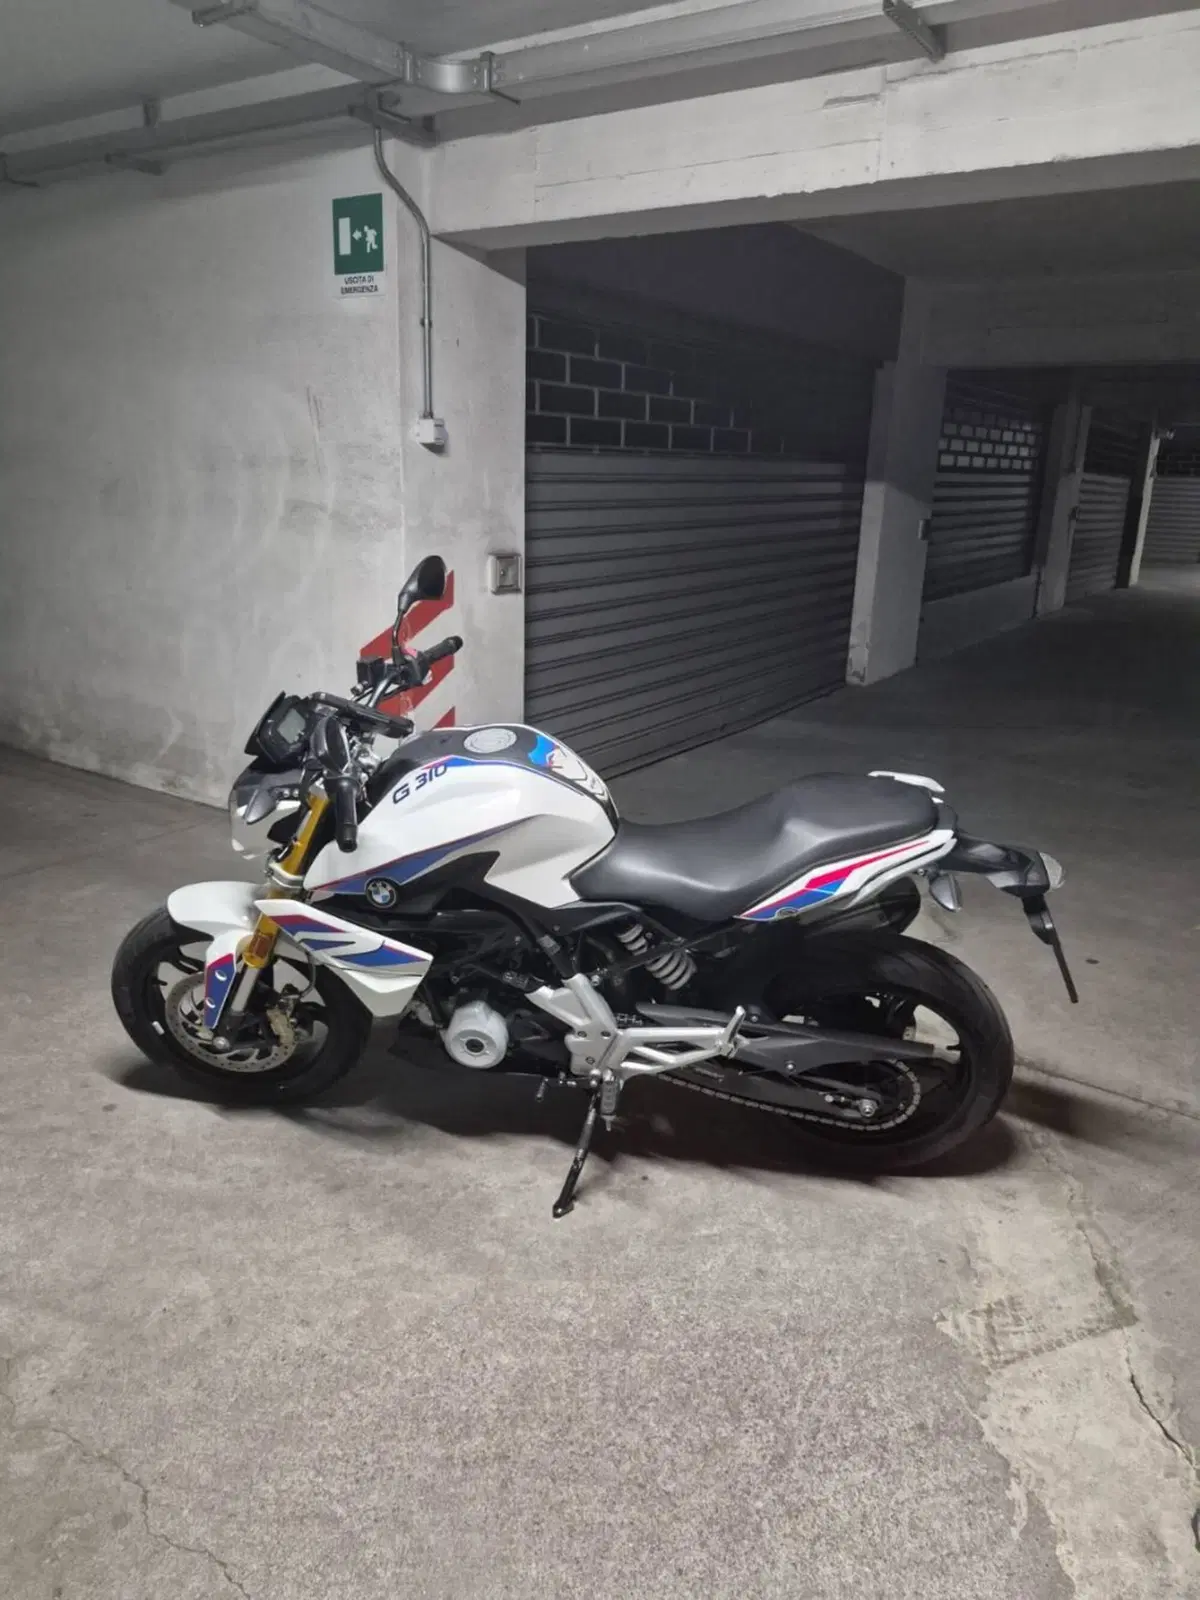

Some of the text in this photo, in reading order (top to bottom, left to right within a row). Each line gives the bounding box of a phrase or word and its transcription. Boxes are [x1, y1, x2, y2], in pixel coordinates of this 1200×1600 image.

[344, 275, 375, 285] USCITA DI
[392, 763, 447, 804] G 310
